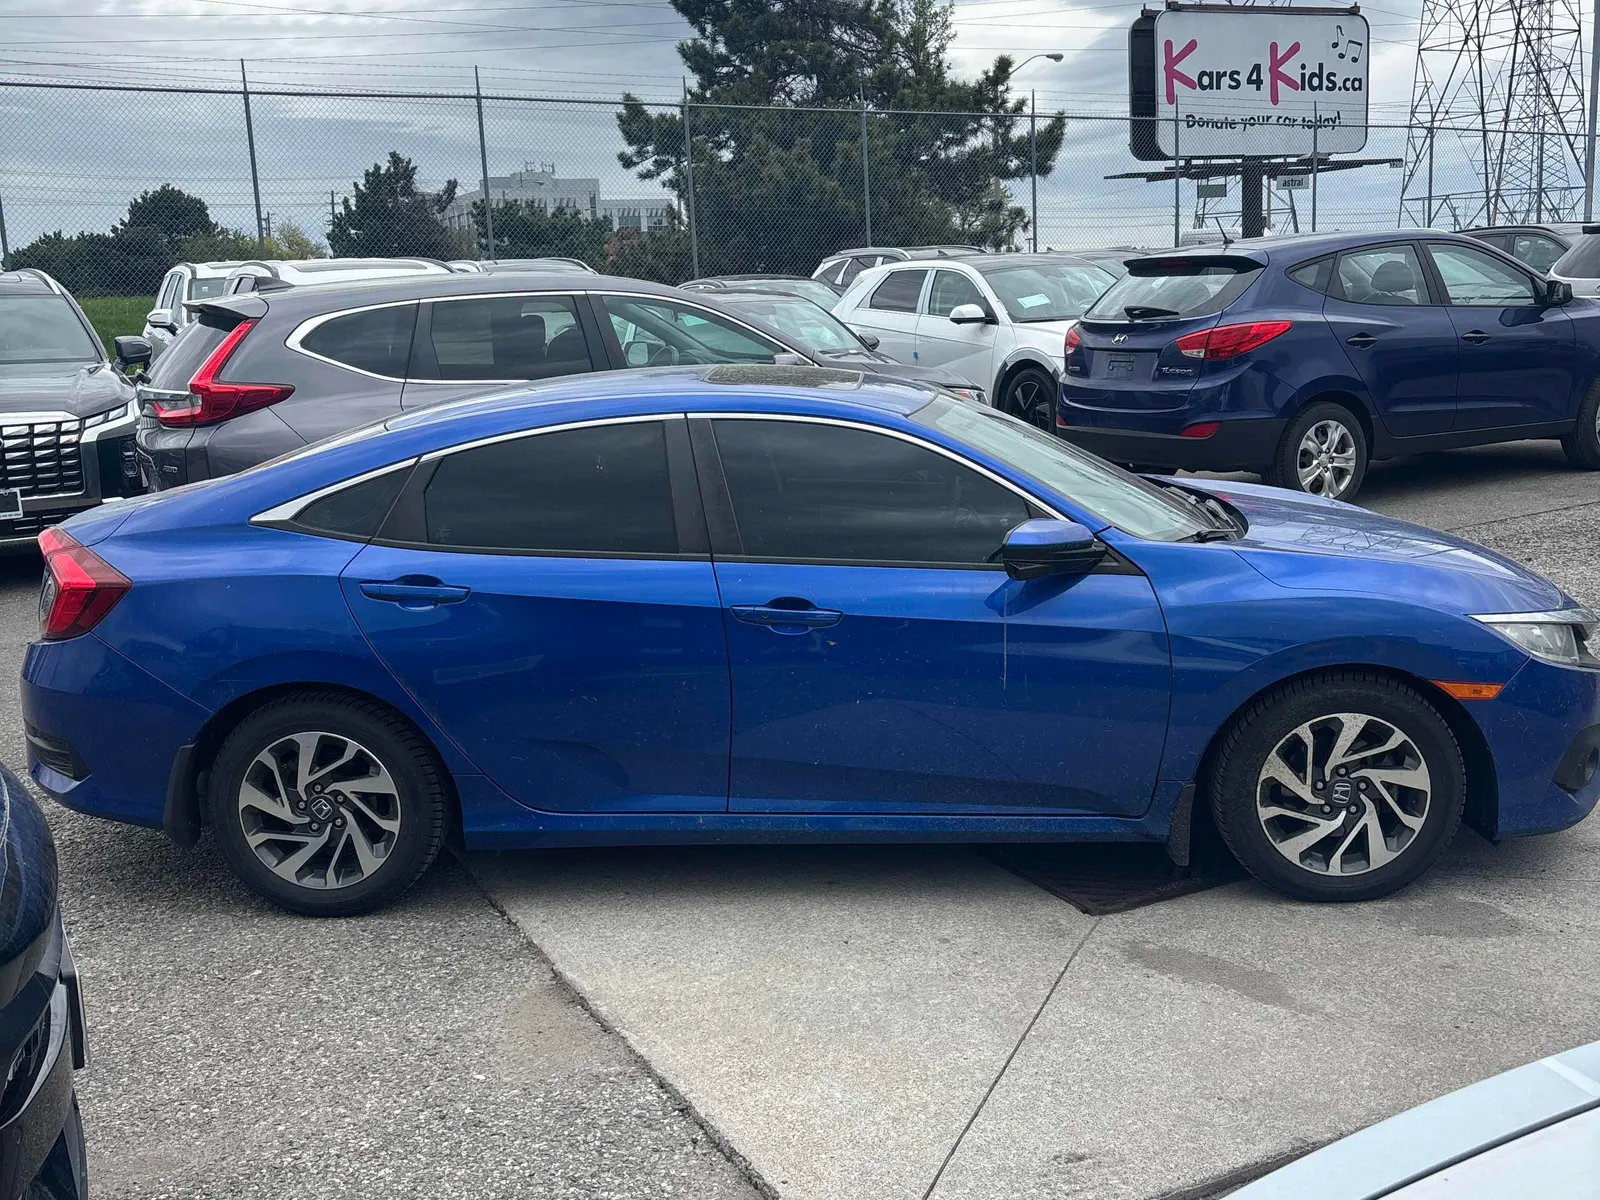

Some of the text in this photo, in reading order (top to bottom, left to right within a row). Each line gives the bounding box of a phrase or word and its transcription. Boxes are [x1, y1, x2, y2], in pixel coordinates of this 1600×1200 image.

[1185, 111, 1342, 131] Donate your car today!
[1282, 177, 1304, 187] astral
